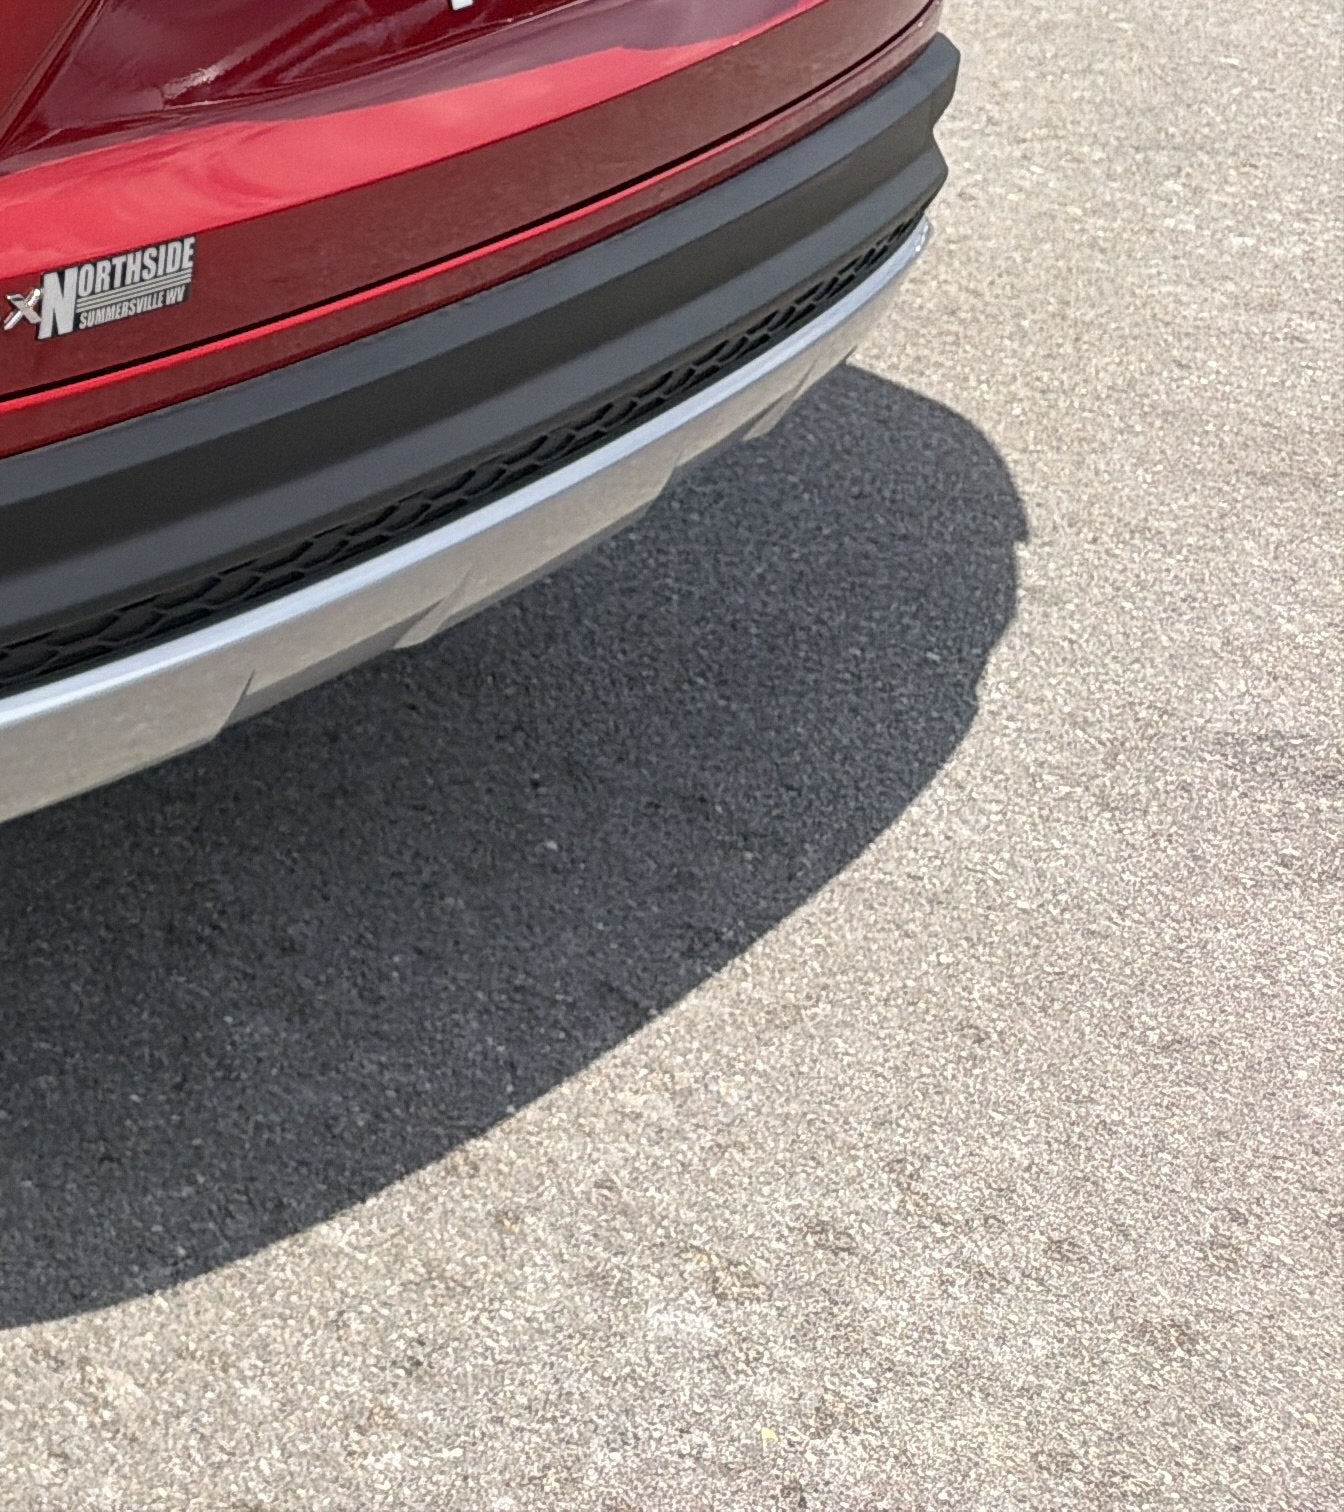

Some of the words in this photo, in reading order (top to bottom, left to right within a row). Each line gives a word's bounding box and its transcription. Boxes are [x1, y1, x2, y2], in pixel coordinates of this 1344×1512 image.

[38, 236, 196, 339] NORTHSIDE
[79, 289, 164, 330] SUMMERSVILLE
[165, 285, 186, 305] WV
